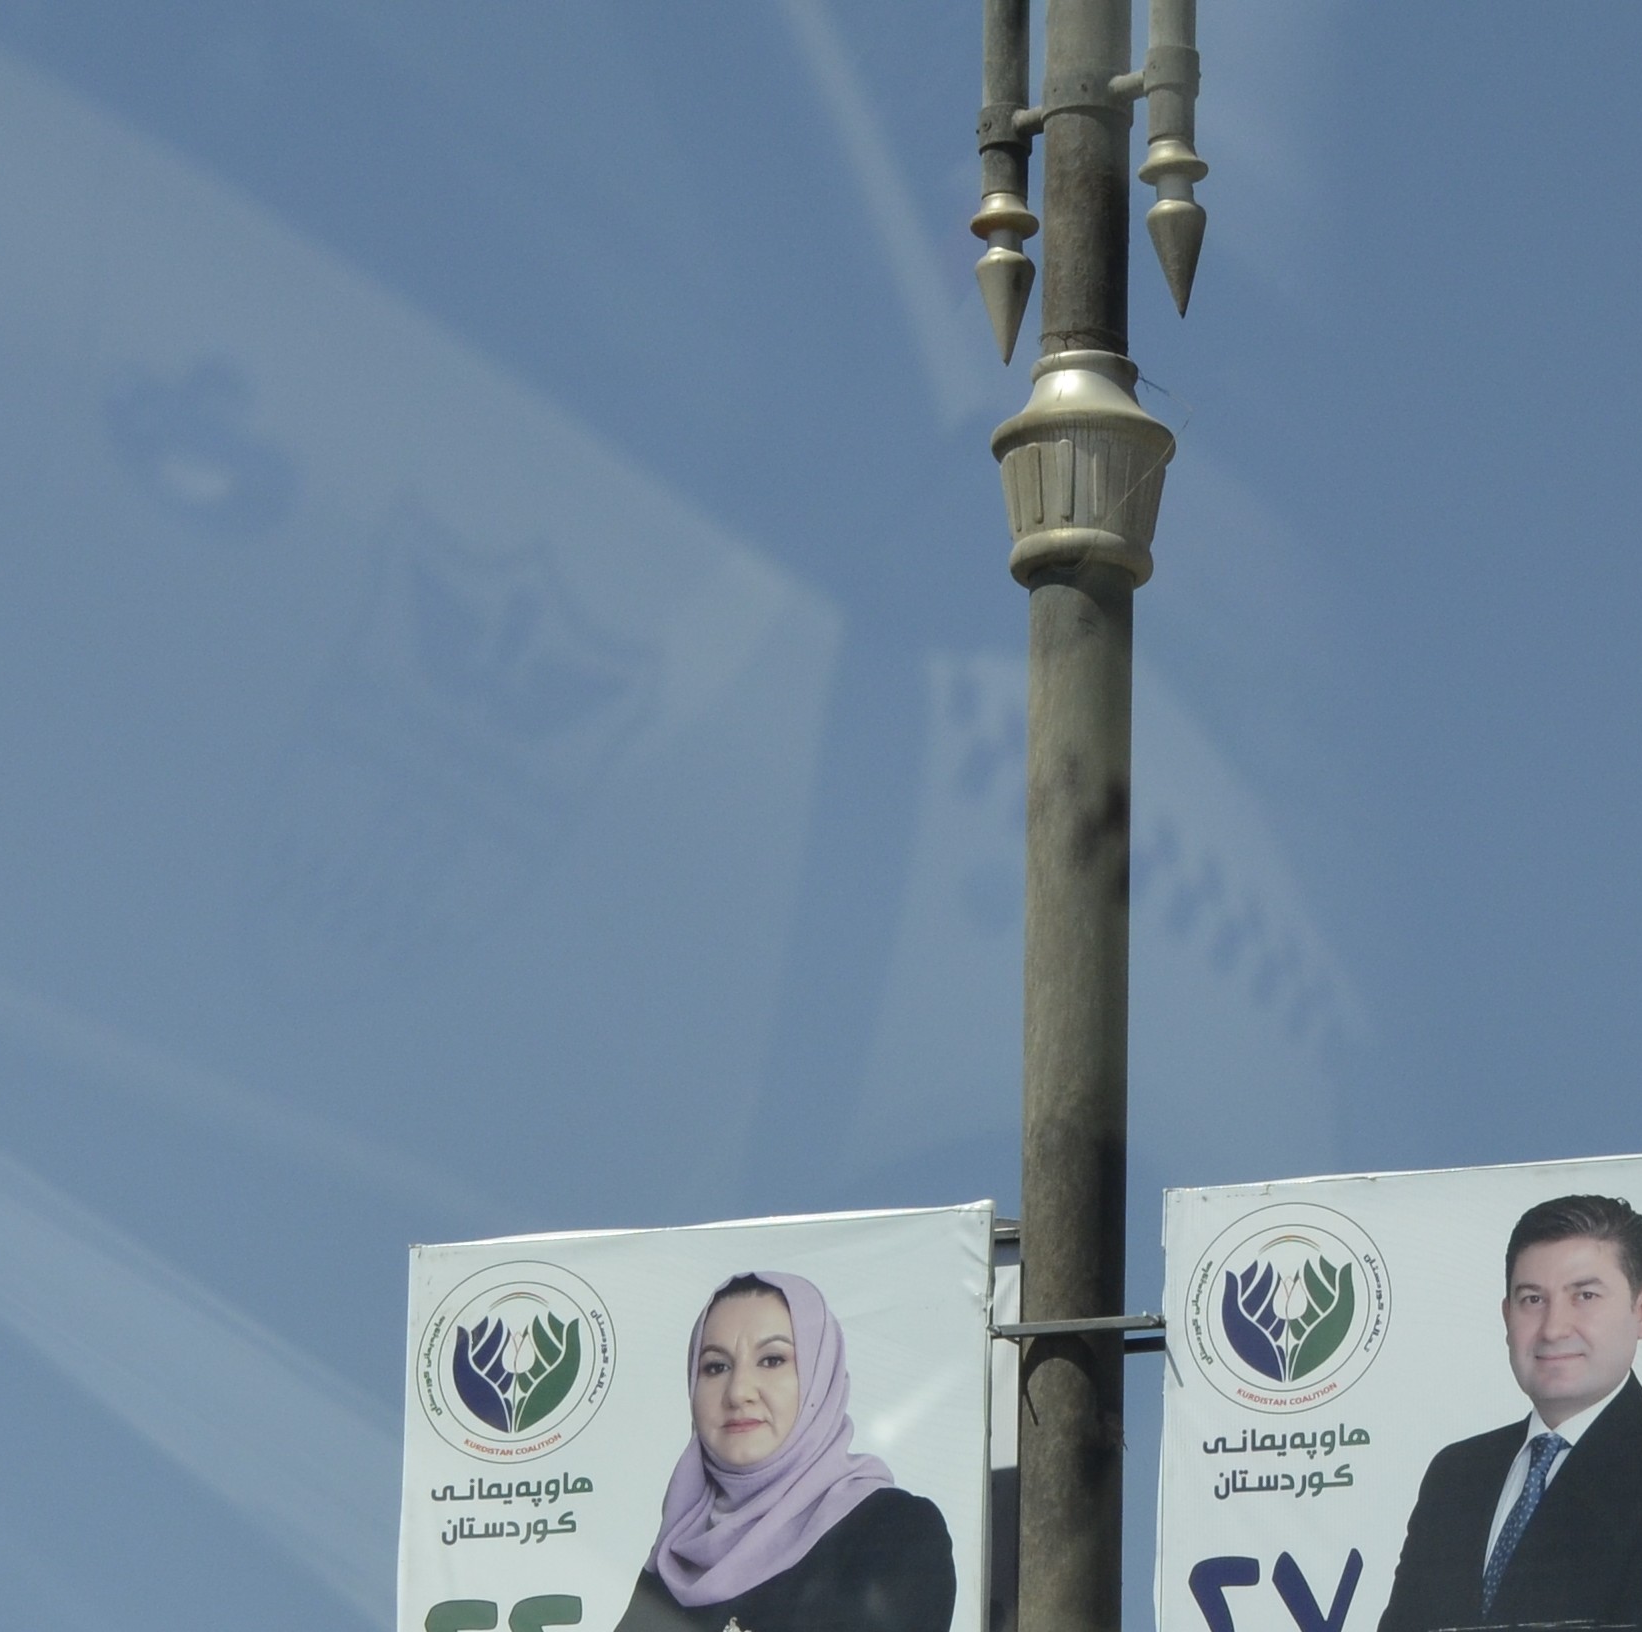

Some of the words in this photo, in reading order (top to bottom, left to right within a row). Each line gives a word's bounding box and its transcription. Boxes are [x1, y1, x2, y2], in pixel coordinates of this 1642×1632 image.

[1236, 1388, 1287, 1406] KURDISTAN
[1289, 1382, 1338, 1405] COALITION
[464, 1438, 513, 1456] KURDISTAN
[515, 1433, 562, 1455] COALITION
